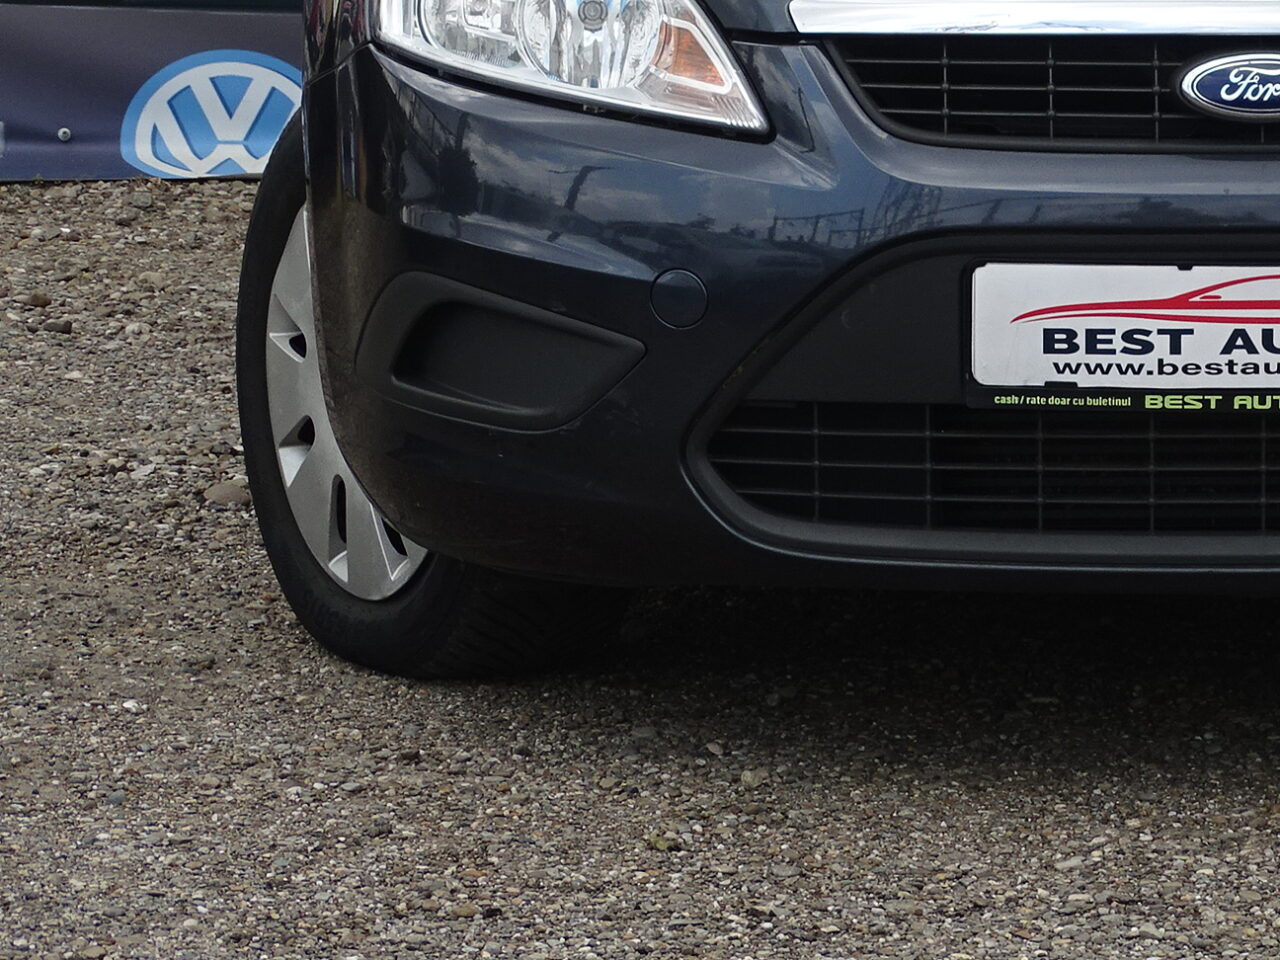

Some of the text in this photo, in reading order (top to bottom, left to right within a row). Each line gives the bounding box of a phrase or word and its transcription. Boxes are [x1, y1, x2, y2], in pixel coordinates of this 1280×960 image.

[1042, 328, 1194, 355] BEST
[994, 395, 1018, 405] cash
[1026, 395, 1047, 405] rate
[1048, 395, 1071, 406] doar
[1072, 397, 1085, 406] cu
[1086, 396, 1132, 407] buletinul
[1144, 394, 1223, 410] BEST
